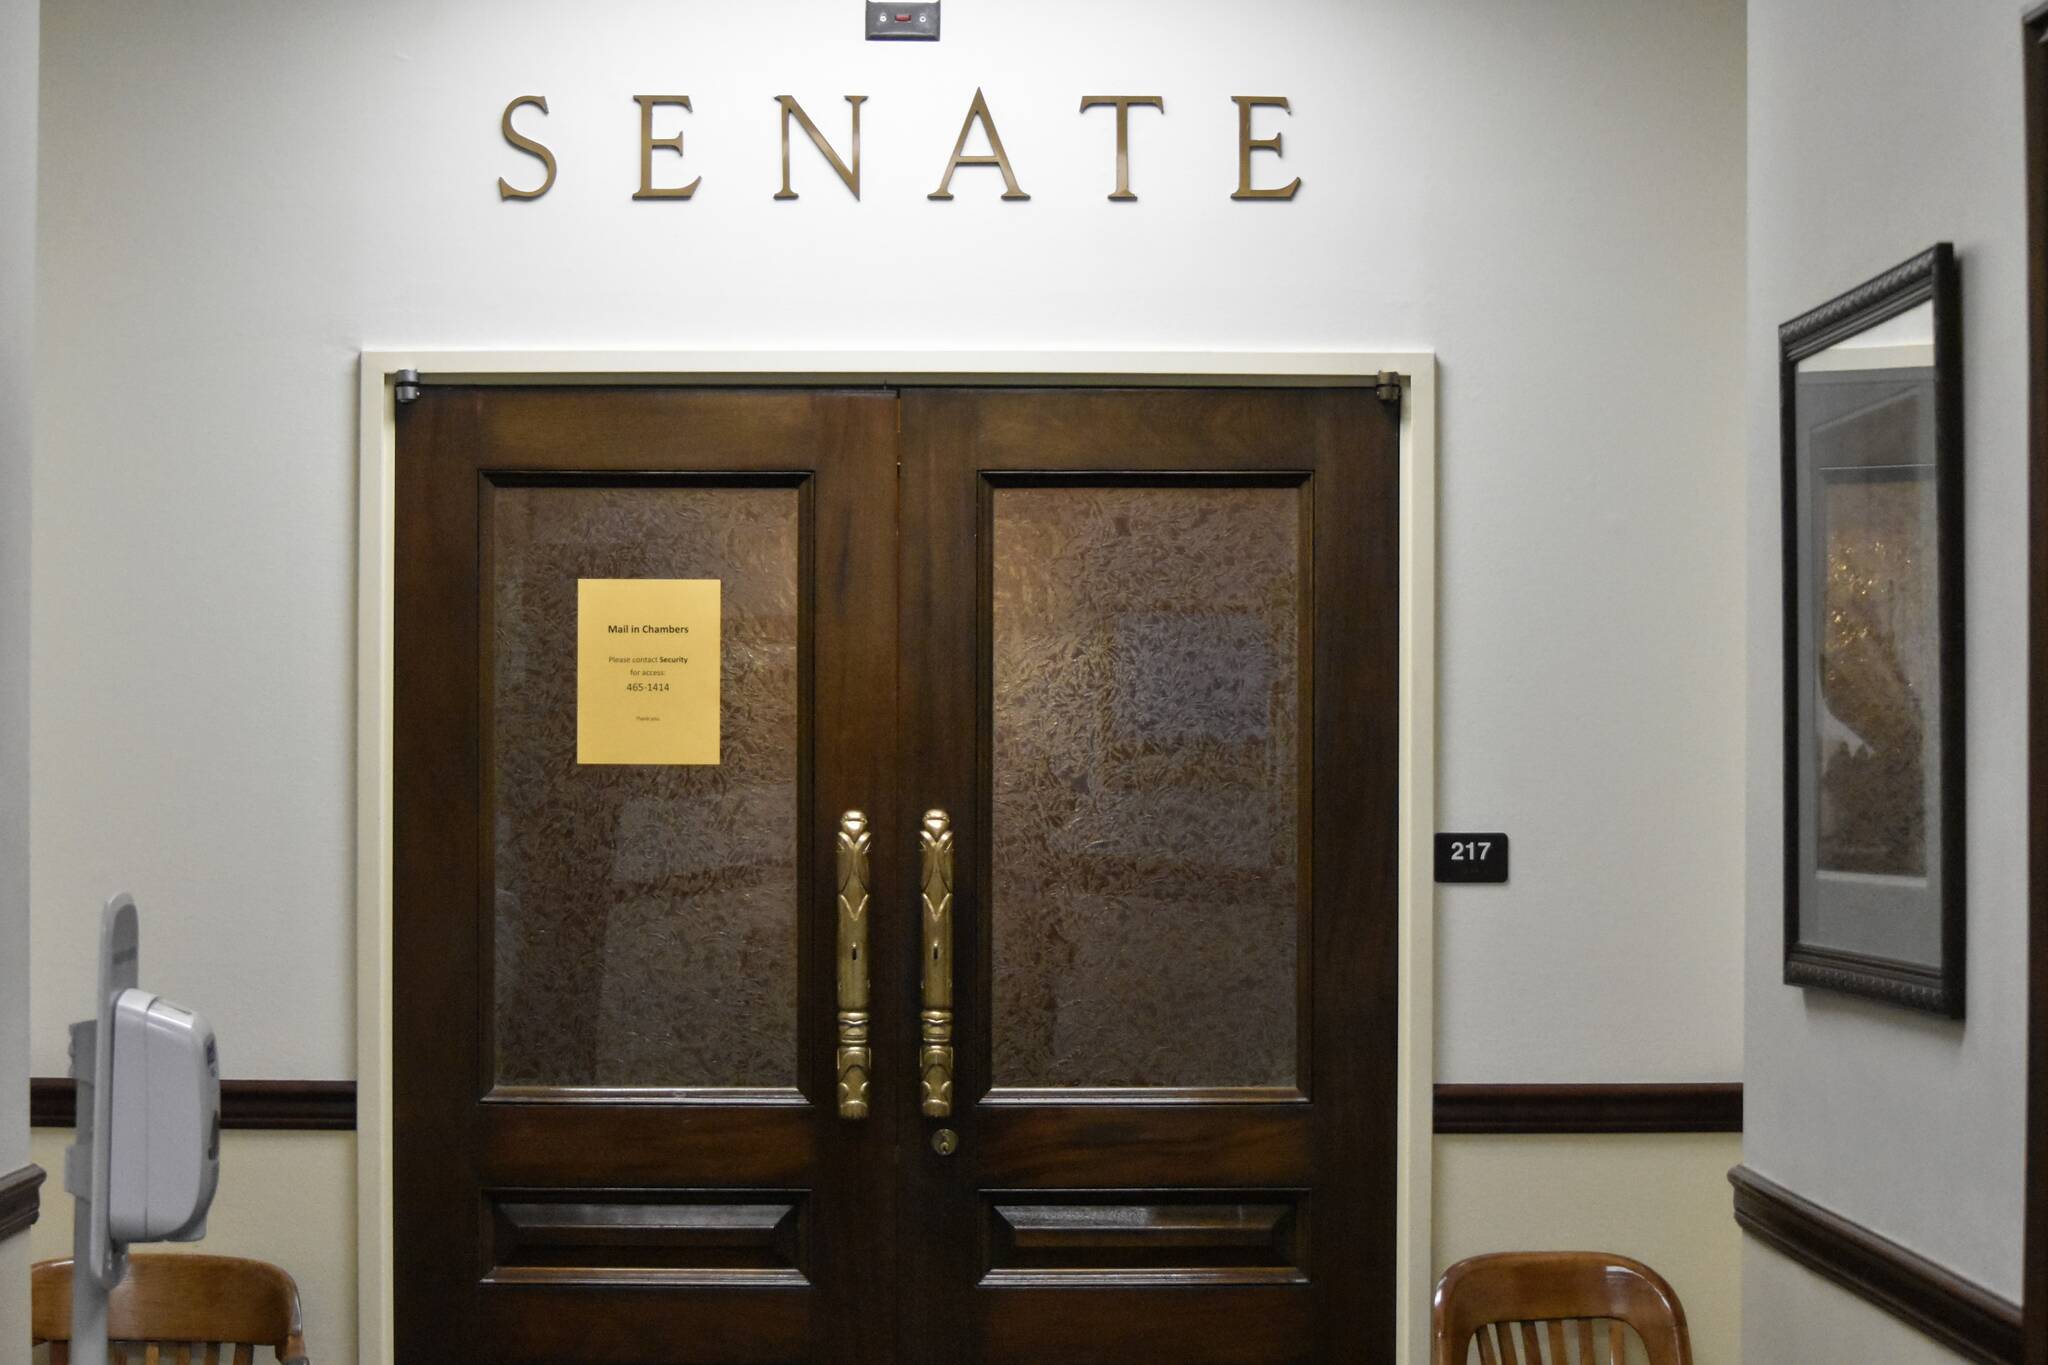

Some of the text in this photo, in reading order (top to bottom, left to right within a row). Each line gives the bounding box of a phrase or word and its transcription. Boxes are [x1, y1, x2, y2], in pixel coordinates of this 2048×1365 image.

[498, 88, 1302, 202] SENATE
[608, 624, 689, 634] Mail in Chambers
[608, 656, 688, 665] Please contact Security
[626, 682, 670, 692] 465-1414
[1451, 841, 1492, 861] 217
